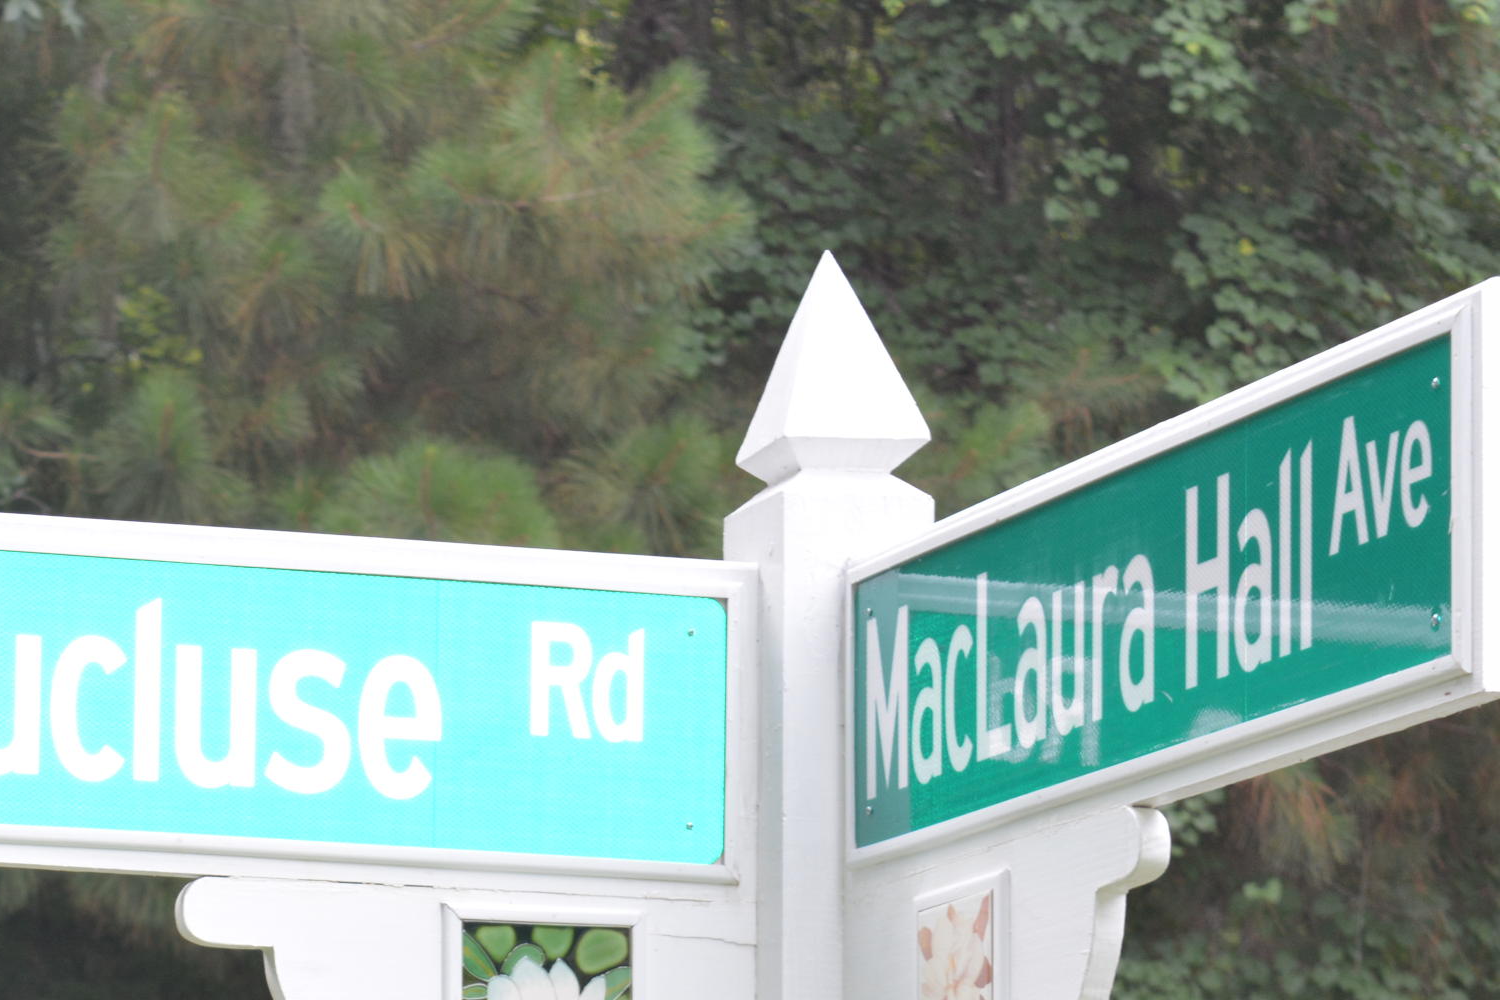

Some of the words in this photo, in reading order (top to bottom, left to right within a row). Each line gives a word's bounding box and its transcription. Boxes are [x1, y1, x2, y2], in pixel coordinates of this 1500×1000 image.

[528, 620, 646, 744] Rd
[866, 554, 1156, 801] MacLaura
[1184, 440, 1313, 690] Hall
[1329, 415, 1432, 556] Ave
